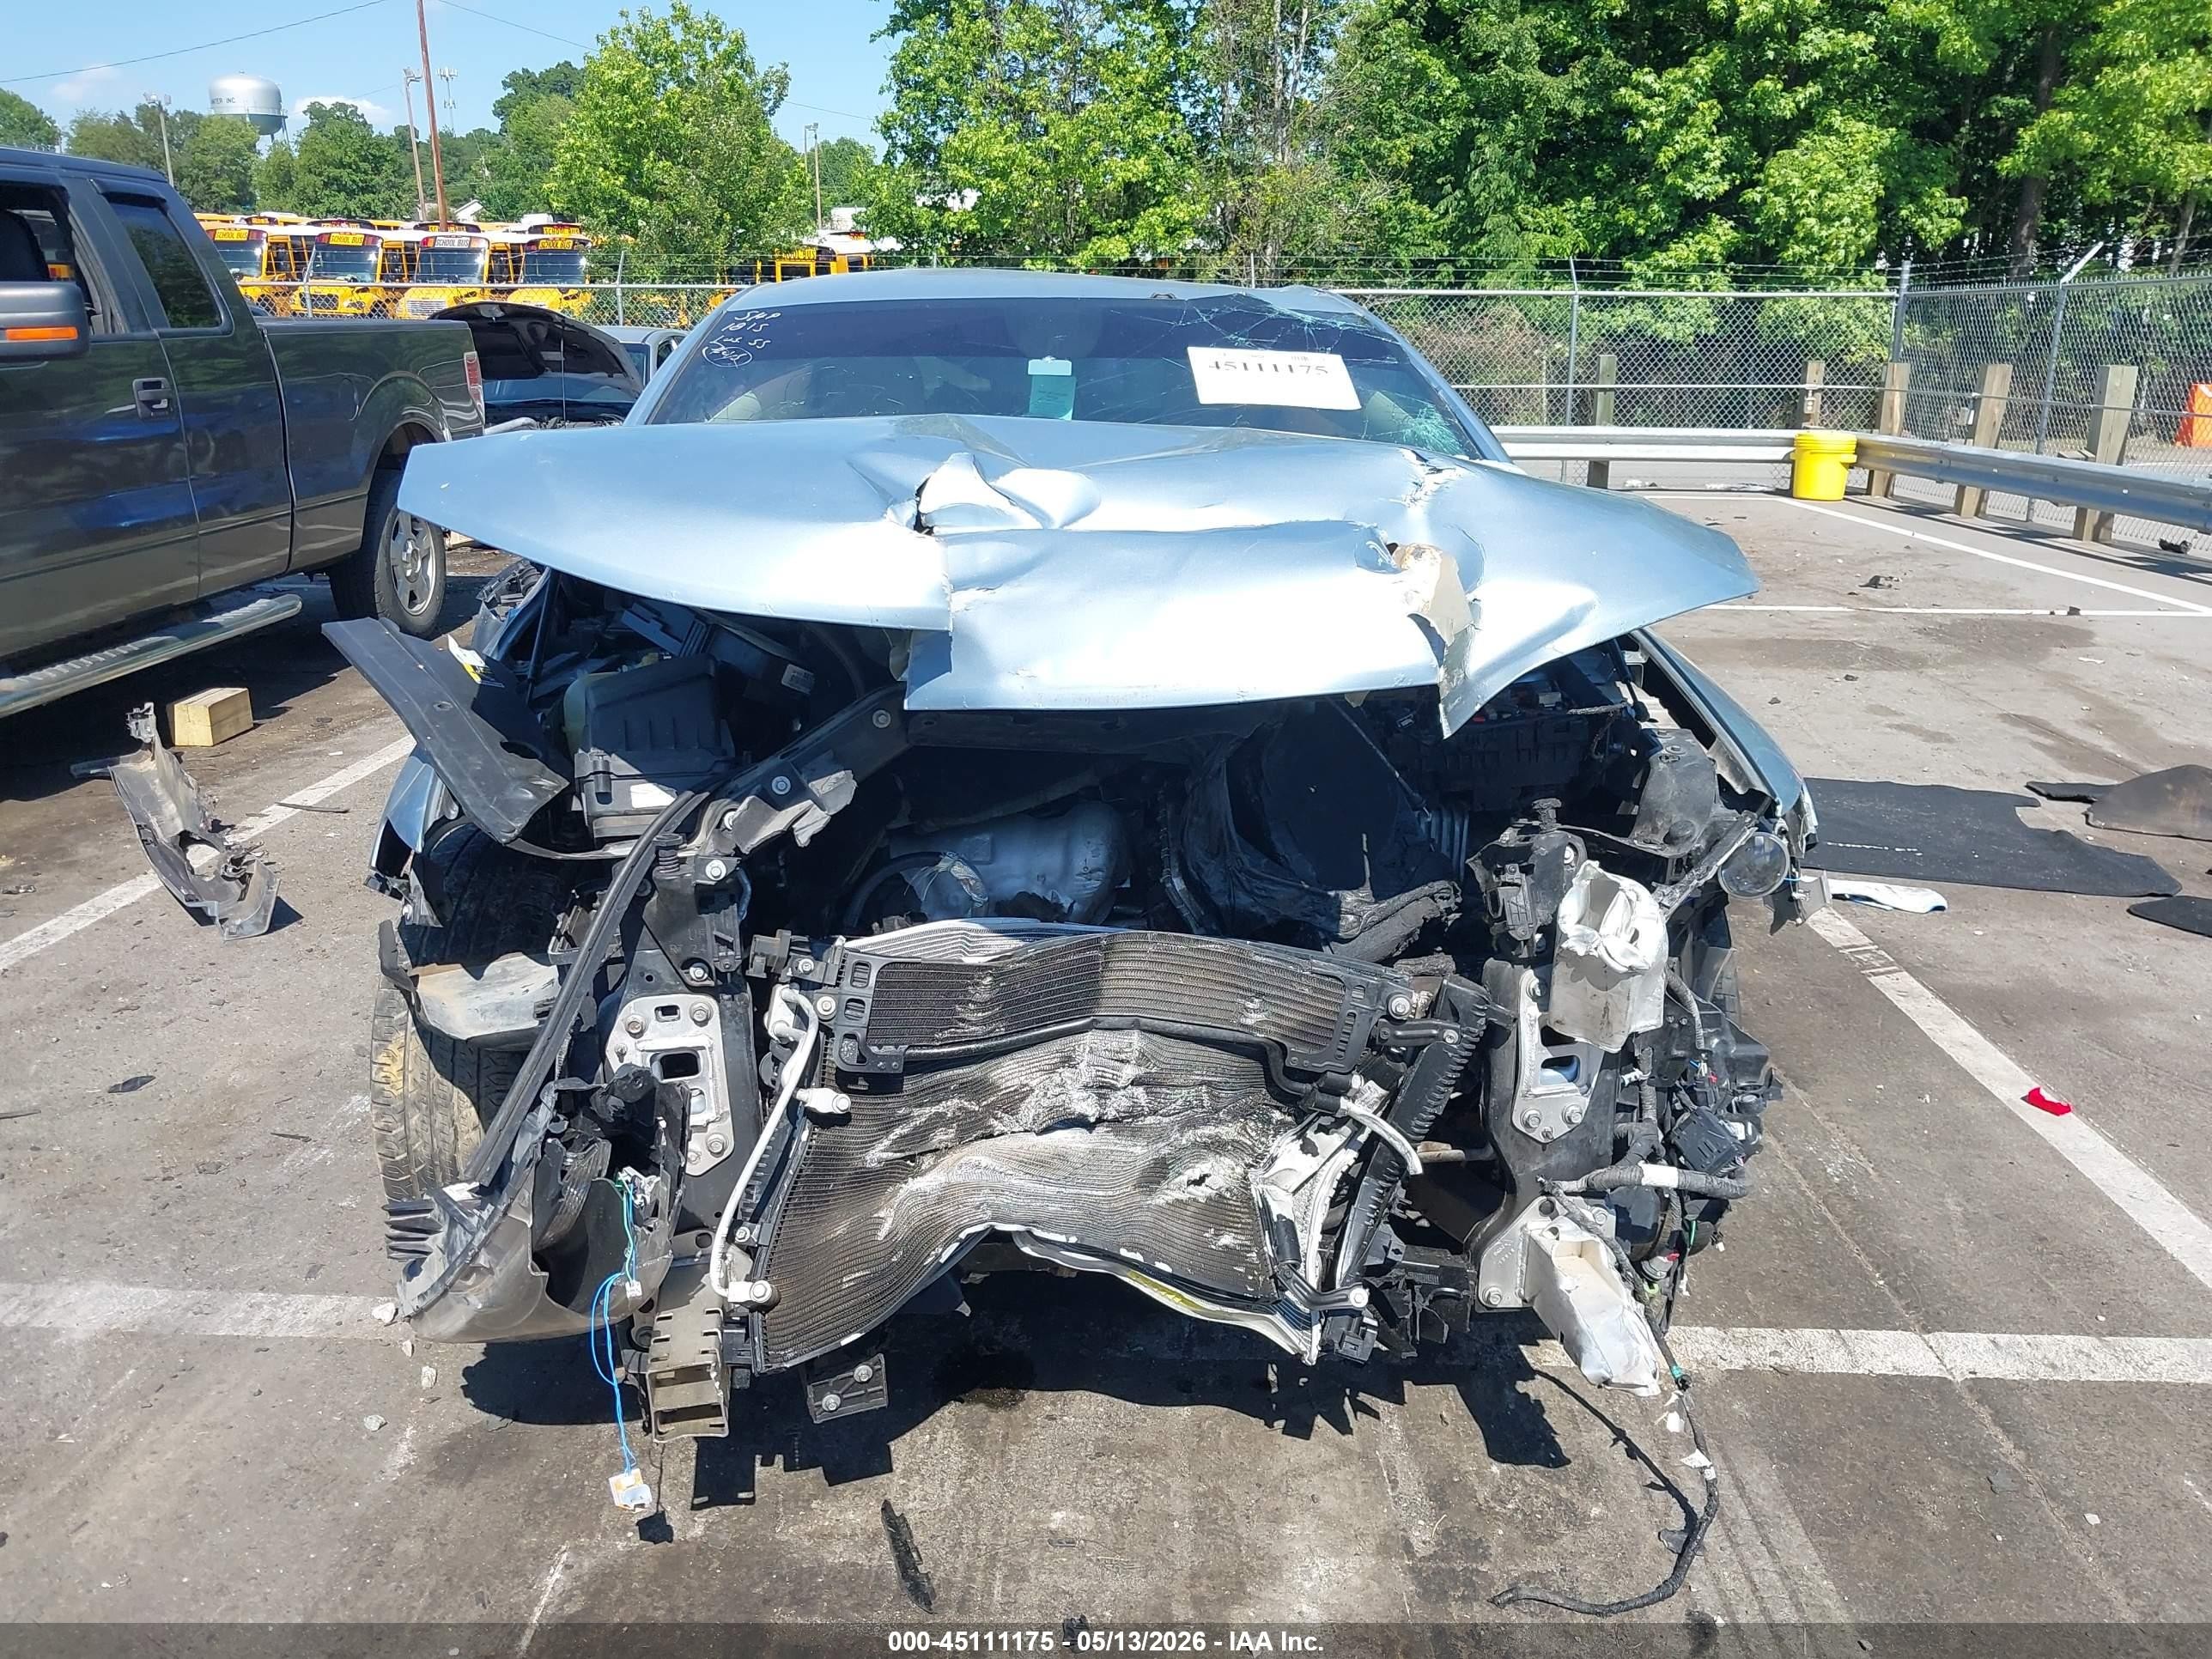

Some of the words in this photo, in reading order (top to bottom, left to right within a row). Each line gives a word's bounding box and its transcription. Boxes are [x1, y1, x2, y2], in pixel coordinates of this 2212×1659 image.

[331, 234, 349, 243] SCHOOL
[720, 322, 769, 332] 1815
[1209, 360, 1328, 375] 45111175
